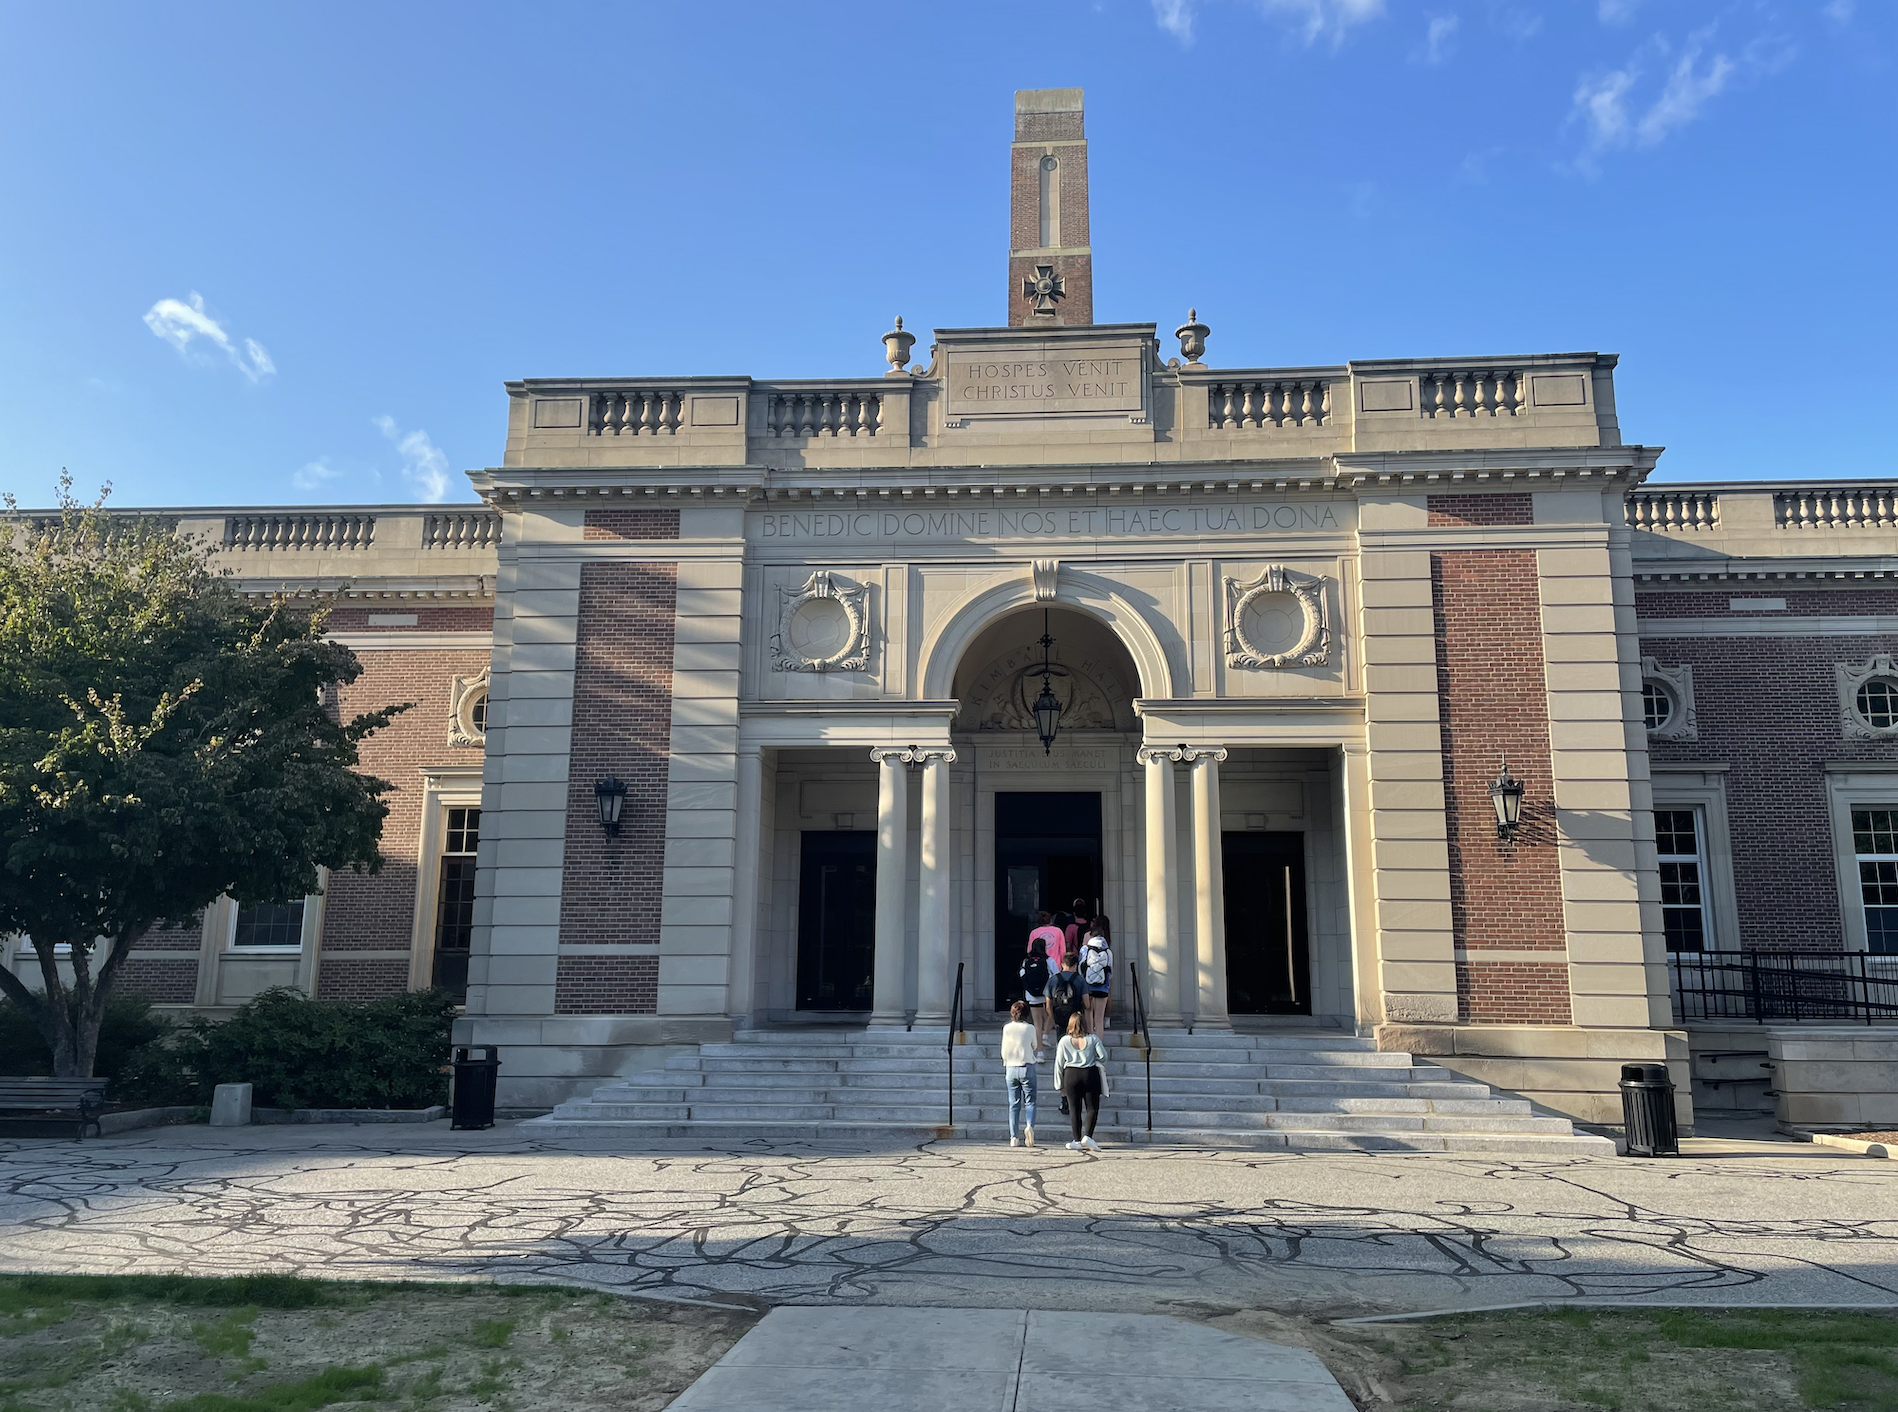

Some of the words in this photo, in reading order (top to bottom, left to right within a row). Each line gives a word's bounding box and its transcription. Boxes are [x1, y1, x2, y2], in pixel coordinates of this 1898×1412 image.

[968, 363, 1048, 378] HOSPES
[1063, 361, 1123, 376] VENIT
[963, 384, 1055, 399] CHRISTUS
[1067, 382, 1128, 397] VENIT
[761, 513, 872, 538] BENEDIC
[883, 512, 990, 536] DOMINE
[1000, 511, 1057, 535] NOS
[1068, 510, 1098, 534] ET
[1108, 508, 1182, 533] HAEC
[1187, 507, 1242, 531] TUA
[1253, 505, 1339, 530] DONA
[971, 649, 1063, 706] KIMBALL
[1081, 659, 1124, 707] HALL
[988, 749, 1036, 758] JUSTITIA
[1042, 749, 1065, 758] EUS
[1071, 749, 1106, 758] MANET
[989, 760, 1000, 769] IN
[1006, 760, 1060, 769] SAECULUM
[1065, 760, 1107, 769] SAECULI
